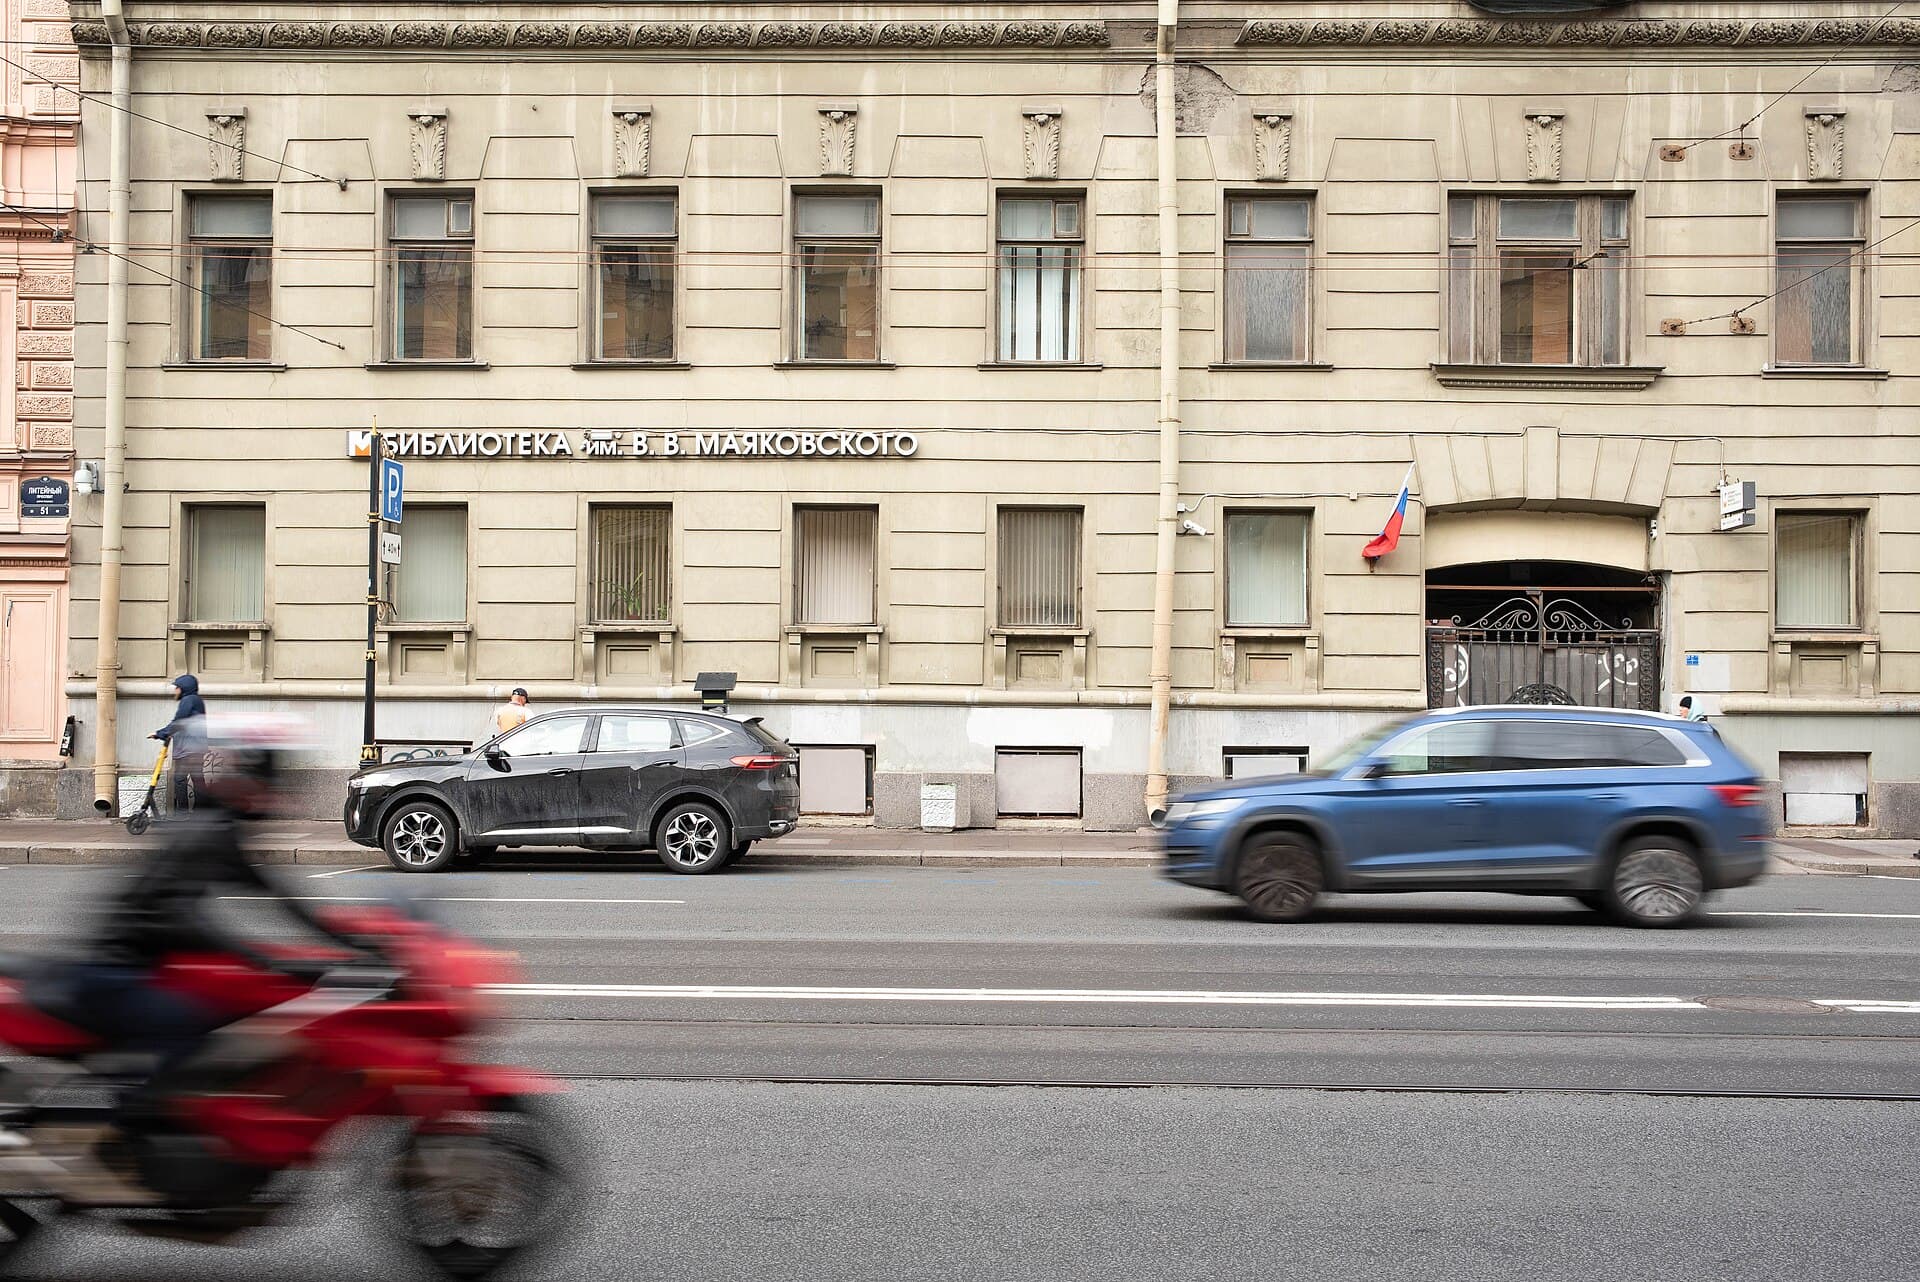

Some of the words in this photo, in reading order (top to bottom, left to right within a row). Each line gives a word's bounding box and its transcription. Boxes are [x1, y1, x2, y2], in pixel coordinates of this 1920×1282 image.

[382, 432, 572, 456] БИБЛИОТЕКА
[633, 431, 655, 455] В.
[664, 431, 686, 455] В.
[695, 431, 919, 456] МАЯКОВСКОГО
[28, 485, 62, 494] ЛИТЕЙНЫЙ
[388, 467, 399, 513] P
[40, 506, 49, 515] 51
